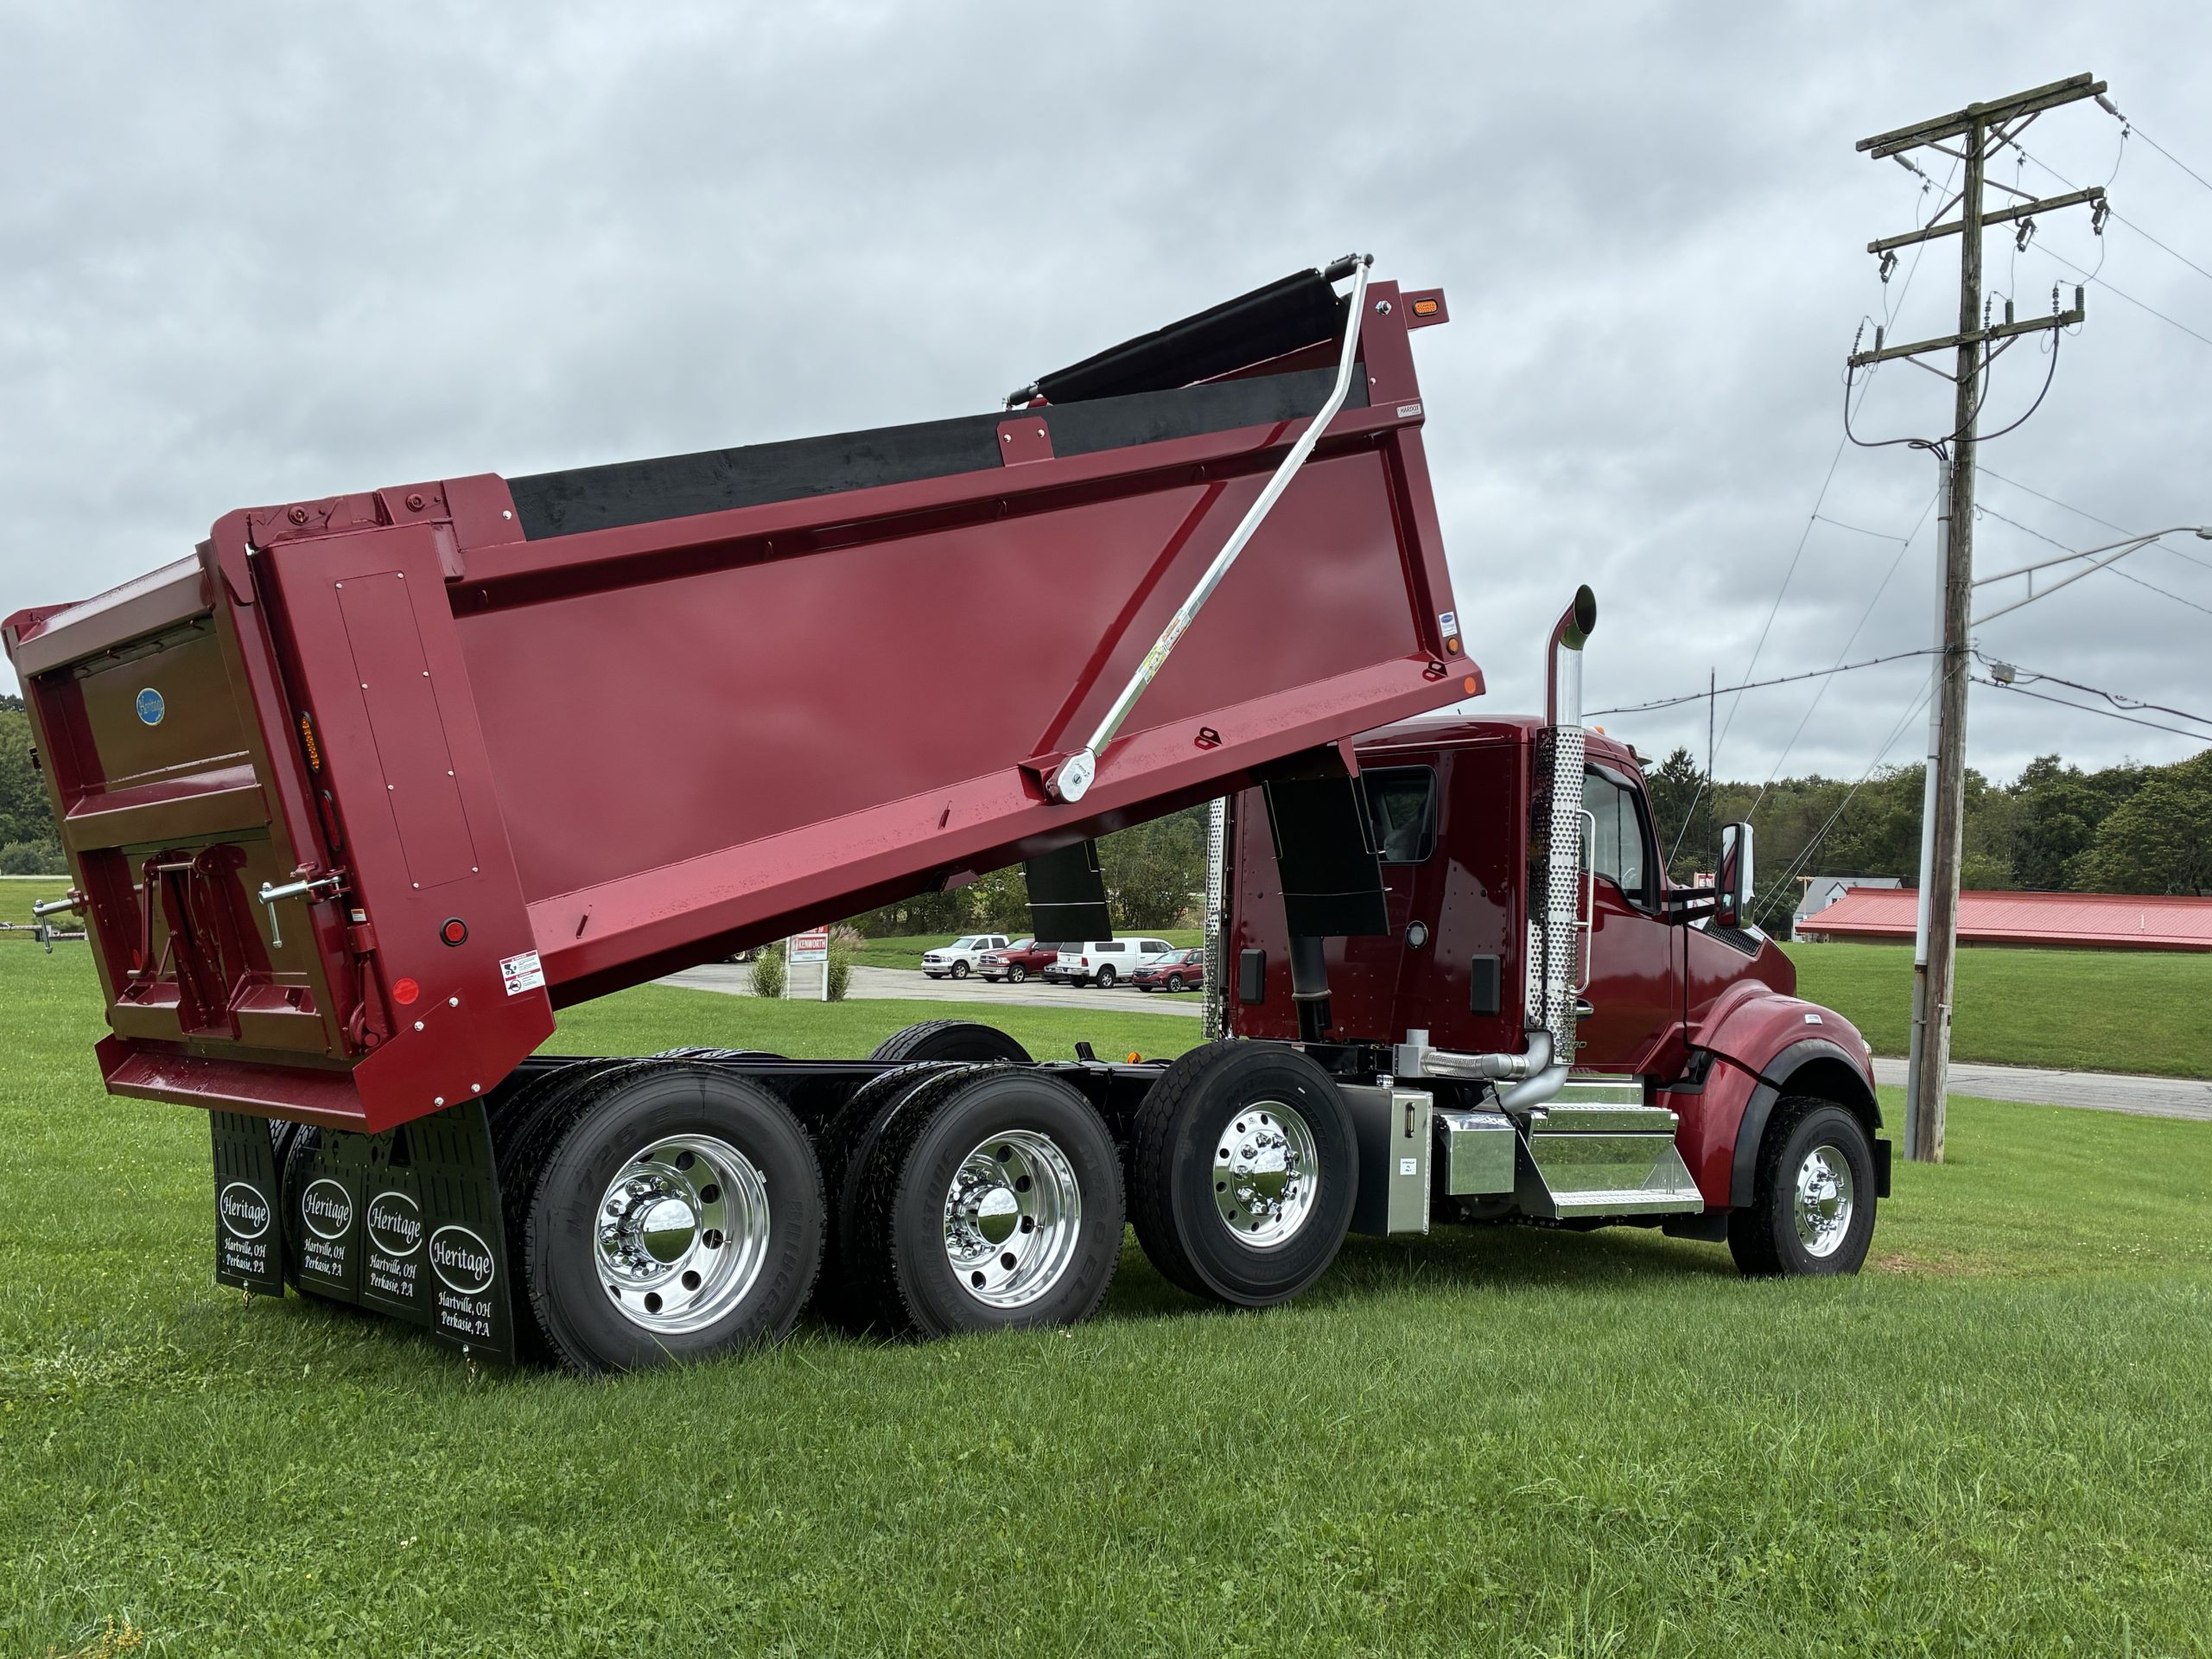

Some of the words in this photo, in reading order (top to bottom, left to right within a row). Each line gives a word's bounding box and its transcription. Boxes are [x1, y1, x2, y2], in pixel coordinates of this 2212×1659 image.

[798, 938, 826, 949] KENWORTH
[223, 1194, 267, 1228] Heritage
[305, 1192, 349, 1228] Heritage
[371, 1205, 421, 1244] Heritage
[225, 1236, 253, 1257] Hartville,
[253, 1244, 267, 1258] OH
[303, 1236, 333, 1259] Hartville,
[333, 1245, 346, 1261] OH
[434, 1240, 491, 1281] Heritage
[226, 1253, 252, 1273] Perkasie,
[252, 1260, 264, 1274] PA
[304, 1255, 331, 1275] Perkasie,
[331, 1262, 342, 1277] PA
[369, 1253, 402, 1277] Hartville,
[403, 1263, 417, 1280] OH
[370, 1272, 399, 1295] Perkasie,
[401, 1281, 413, 1297] PA
[438, 1291, 474, 1316] Hartville,
[475, 1301, 492, 1319] OH
[441, 1311, 474, 1335] Perkasie,
[474, 1320, 491, 1338] PA
